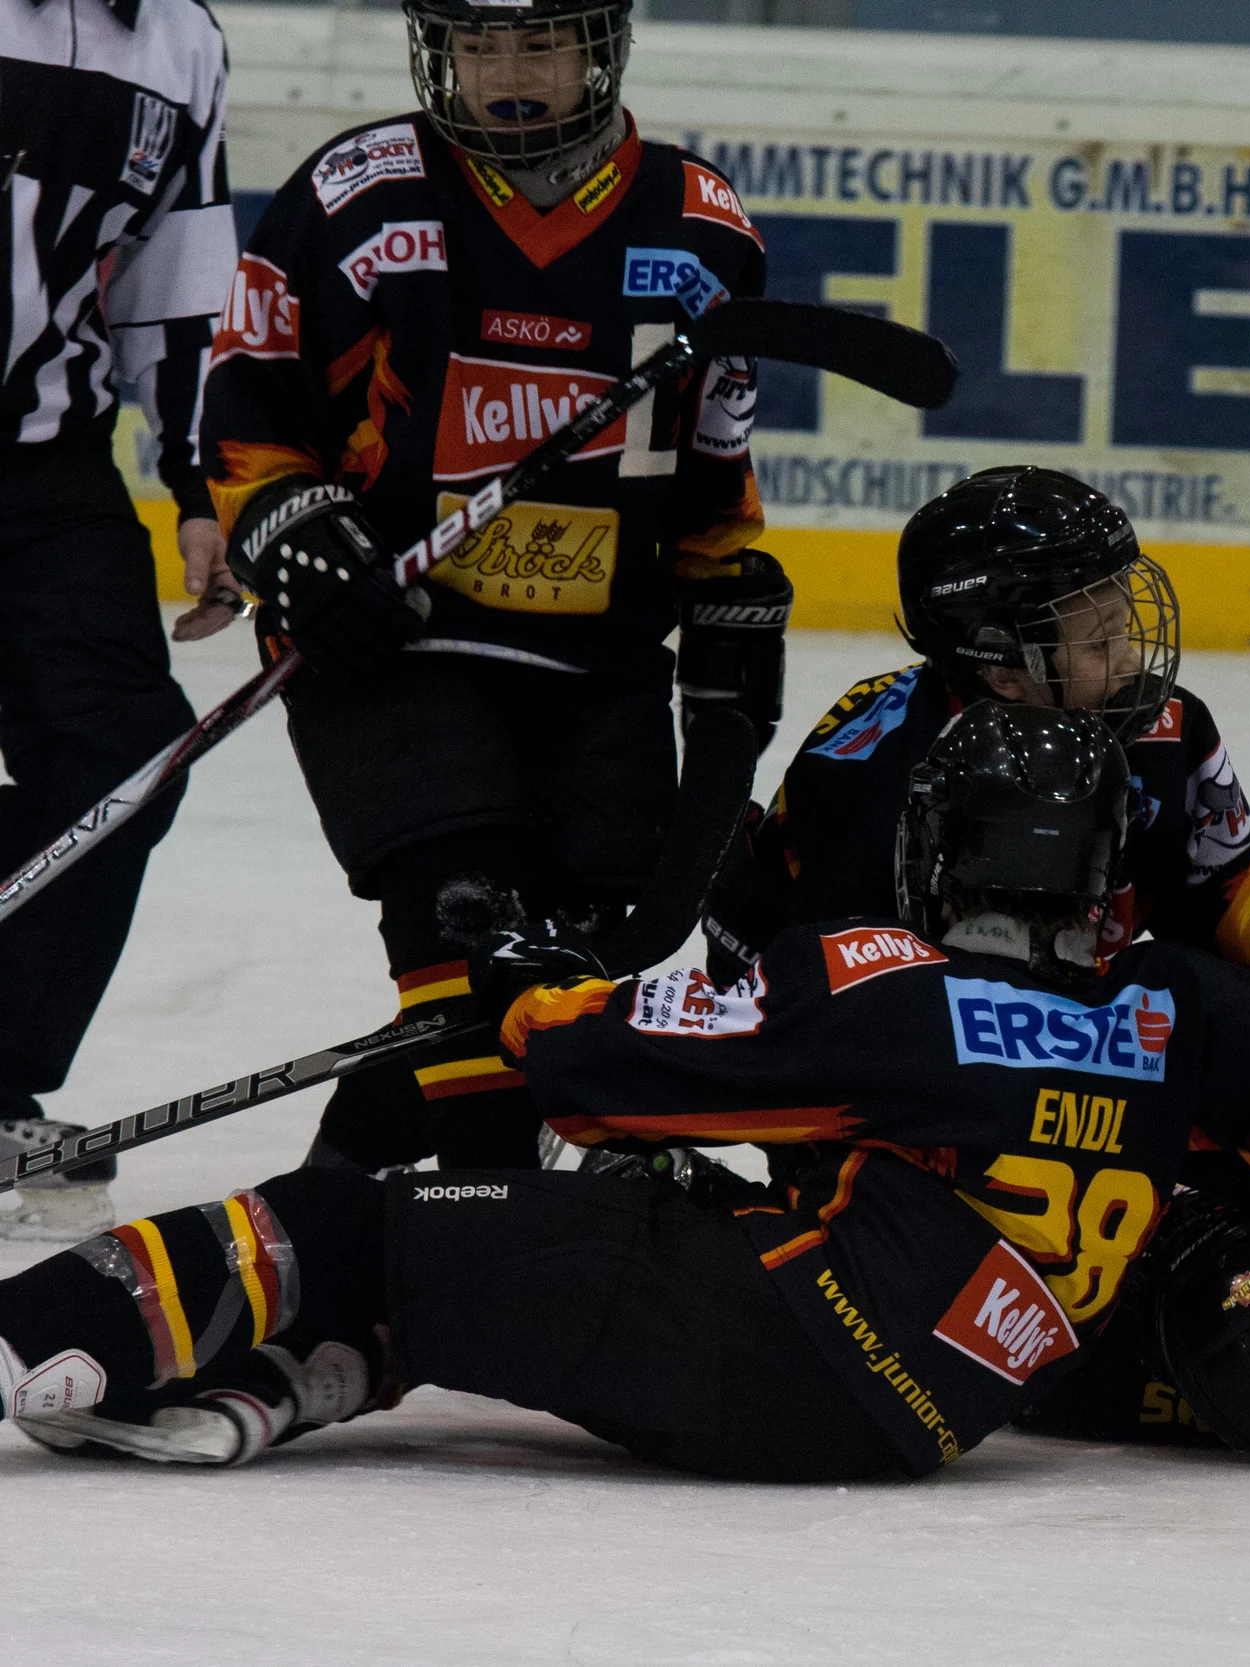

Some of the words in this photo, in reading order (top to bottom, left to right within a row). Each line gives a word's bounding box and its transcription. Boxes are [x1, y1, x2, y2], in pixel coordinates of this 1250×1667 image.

[221, 269, 294, 348] lly's
[487, 316, 551, 343] ASKÖ
[450, 516, 606, 582] Ströck
[472, 580, 563, 600] BROT
[930, 574, 988, 598] BAUER
[955, 646, 1004, 663] BAUER
[836, 932, 931, 970] Kelly's
[354, 1022, 415, 1050] NEXUS
[957, 997, 1136, 1069] ERSTE
[14, 1060, 298, 1180] BAUER
[1028, 1086, 1128, 1155] ENDL
[412, 1184, 509, 1203] Reebok
[957, 1153, 1160, 1324] 28
[973, 1276, 1060, 1370] Kelly's
